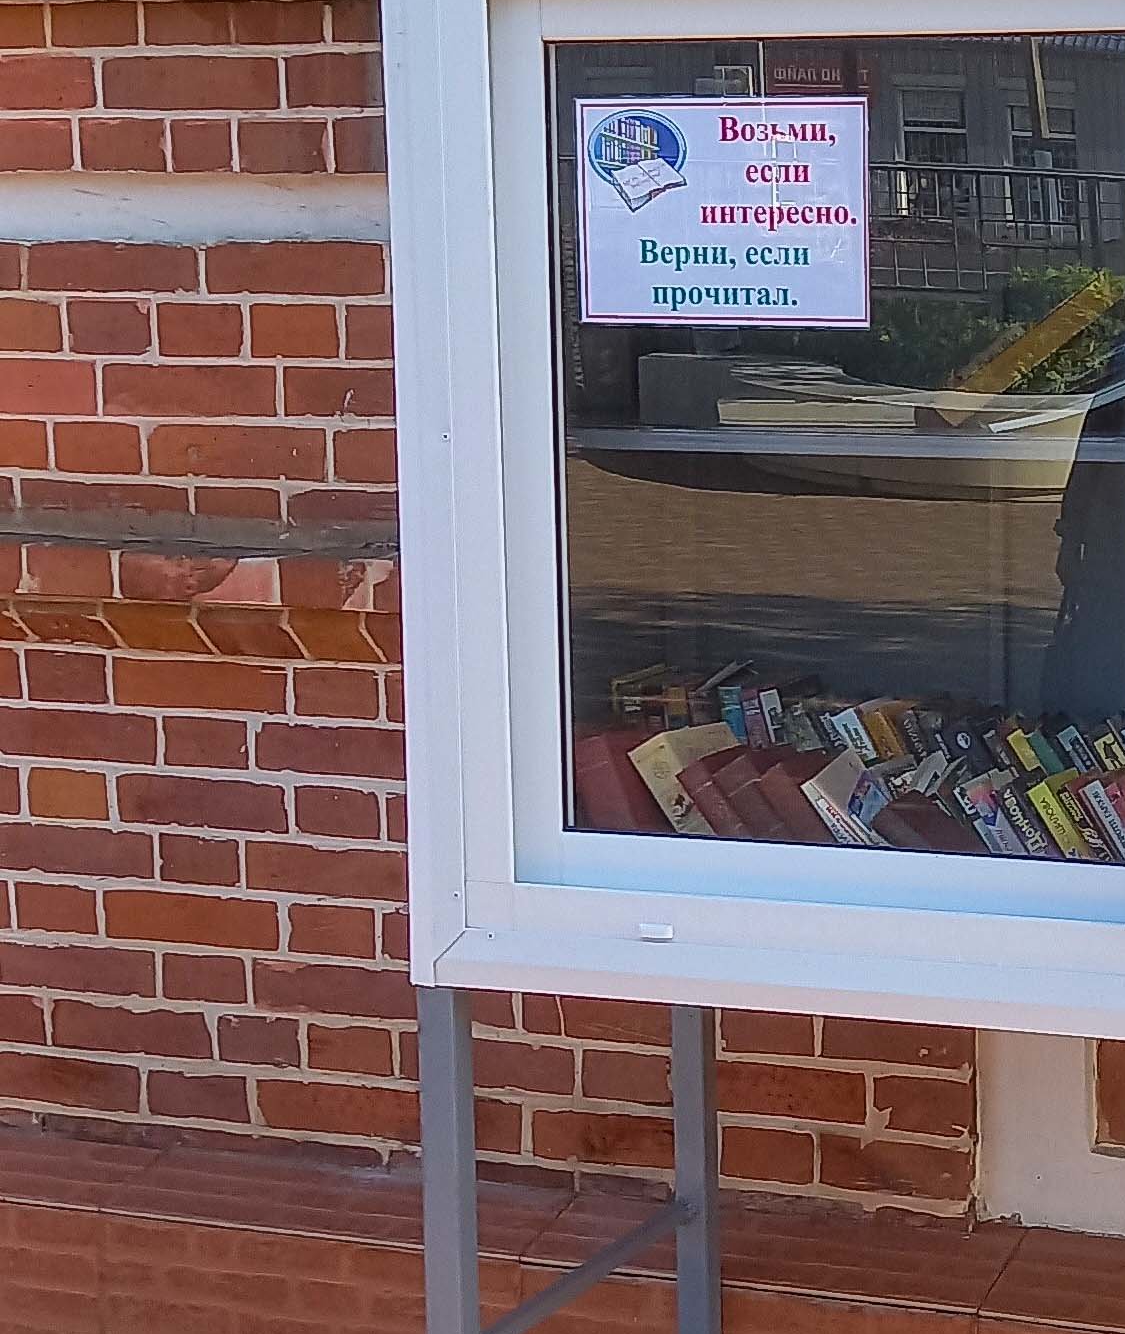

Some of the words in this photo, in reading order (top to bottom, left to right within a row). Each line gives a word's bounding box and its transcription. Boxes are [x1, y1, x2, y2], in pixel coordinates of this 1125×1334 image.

[718, 116, 836, 147] Возьми,
[745, 164, 810, 183] если
[700, 205, 857, 232] интересно.
[639, 237, 737, 270] Верни,
[745, 245, 810, 265] если
[652, 285, 798, 312] прочитал.
